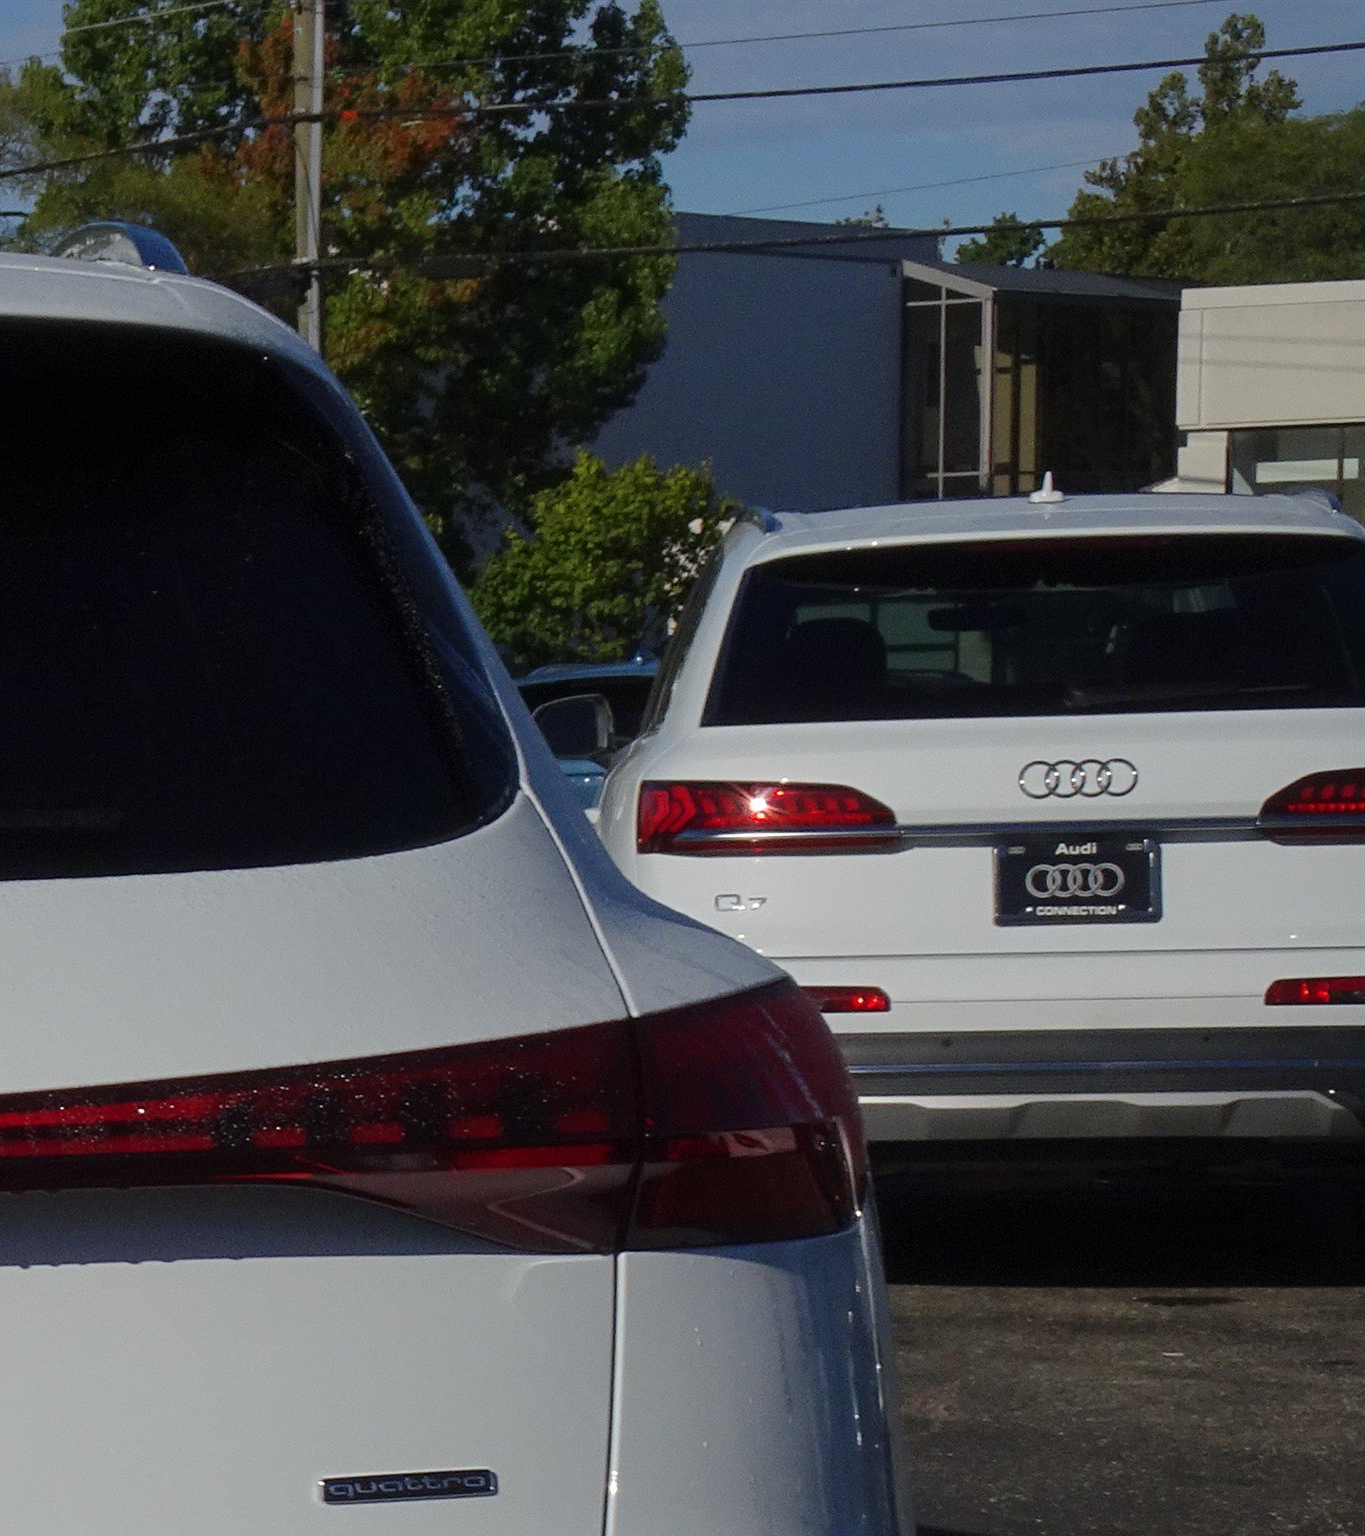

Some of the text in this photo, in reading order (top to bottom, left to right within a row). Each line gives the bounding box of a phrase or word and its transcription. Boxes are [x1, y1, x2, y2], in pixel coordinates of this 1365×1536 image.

[1055, 843, 1096, 855] Audi
[715, 894, 766, 911] Q7
[1036, 906, 1117, 915] CONNECTION
[329, 1475, 485, 1497] quattro
